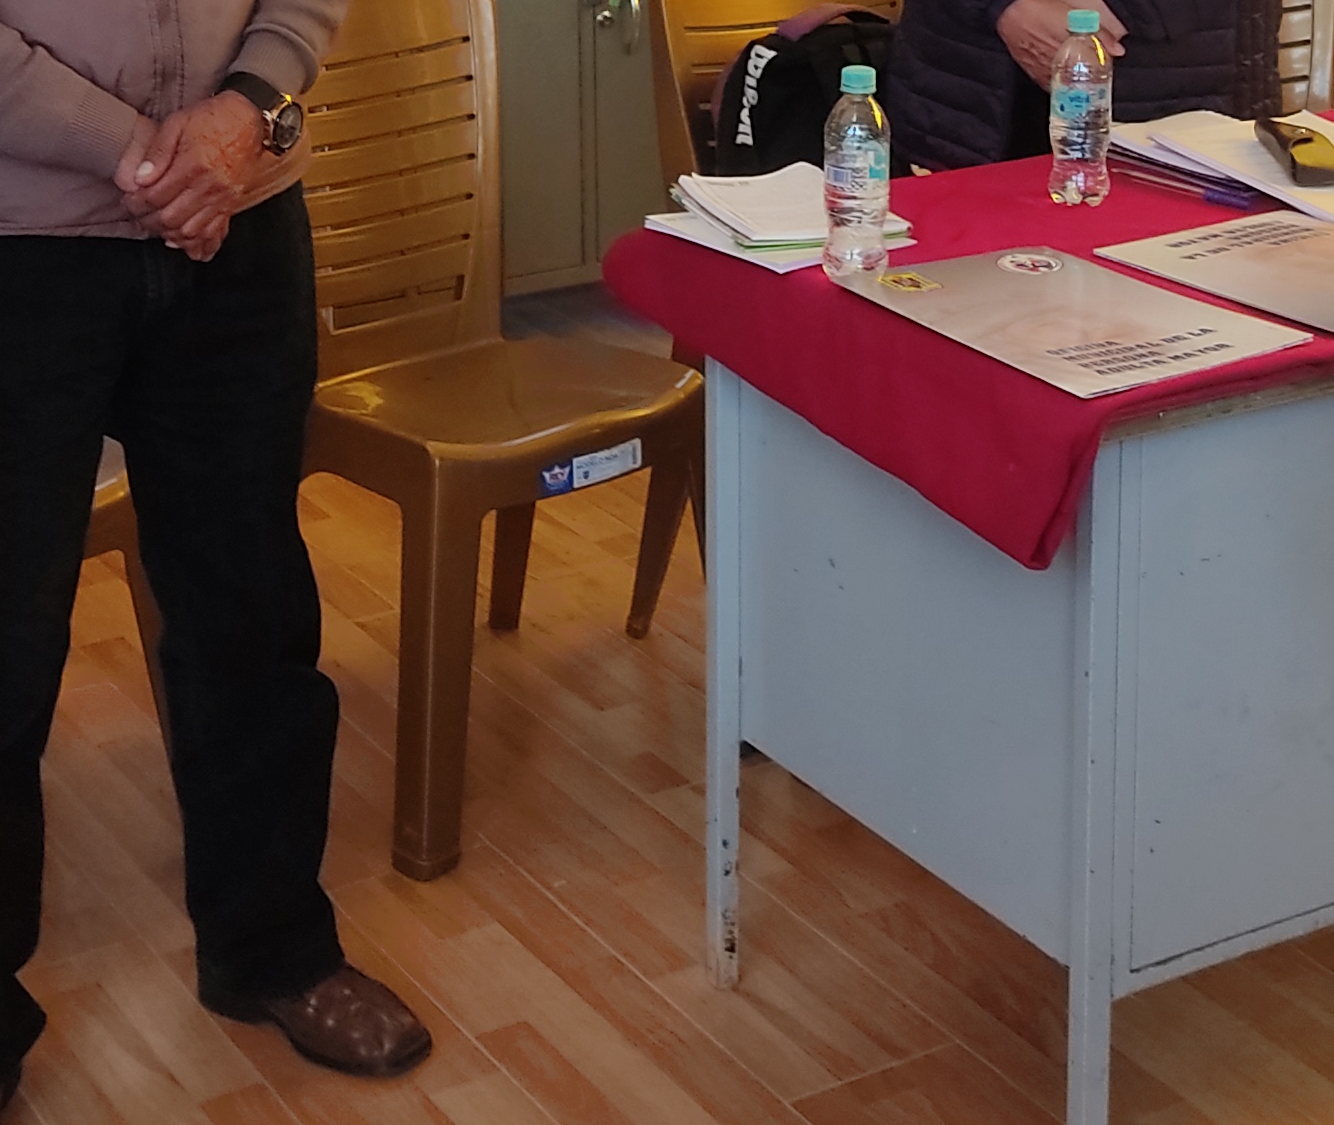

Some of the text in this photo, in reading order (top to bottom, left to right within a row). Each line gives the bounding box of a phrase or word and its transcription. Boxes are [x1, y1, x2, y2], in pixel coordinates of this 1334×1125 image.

[1179, 252, 1208, 261] LA
[1205, 246, 1231, 255] DE
[1062, 327, 1219, 362] MUNICIPAL DE LA
[1077, 350, 1168, 369] PERSONA
[1094, 342, 1235, 376] ADULTA MAYOR
